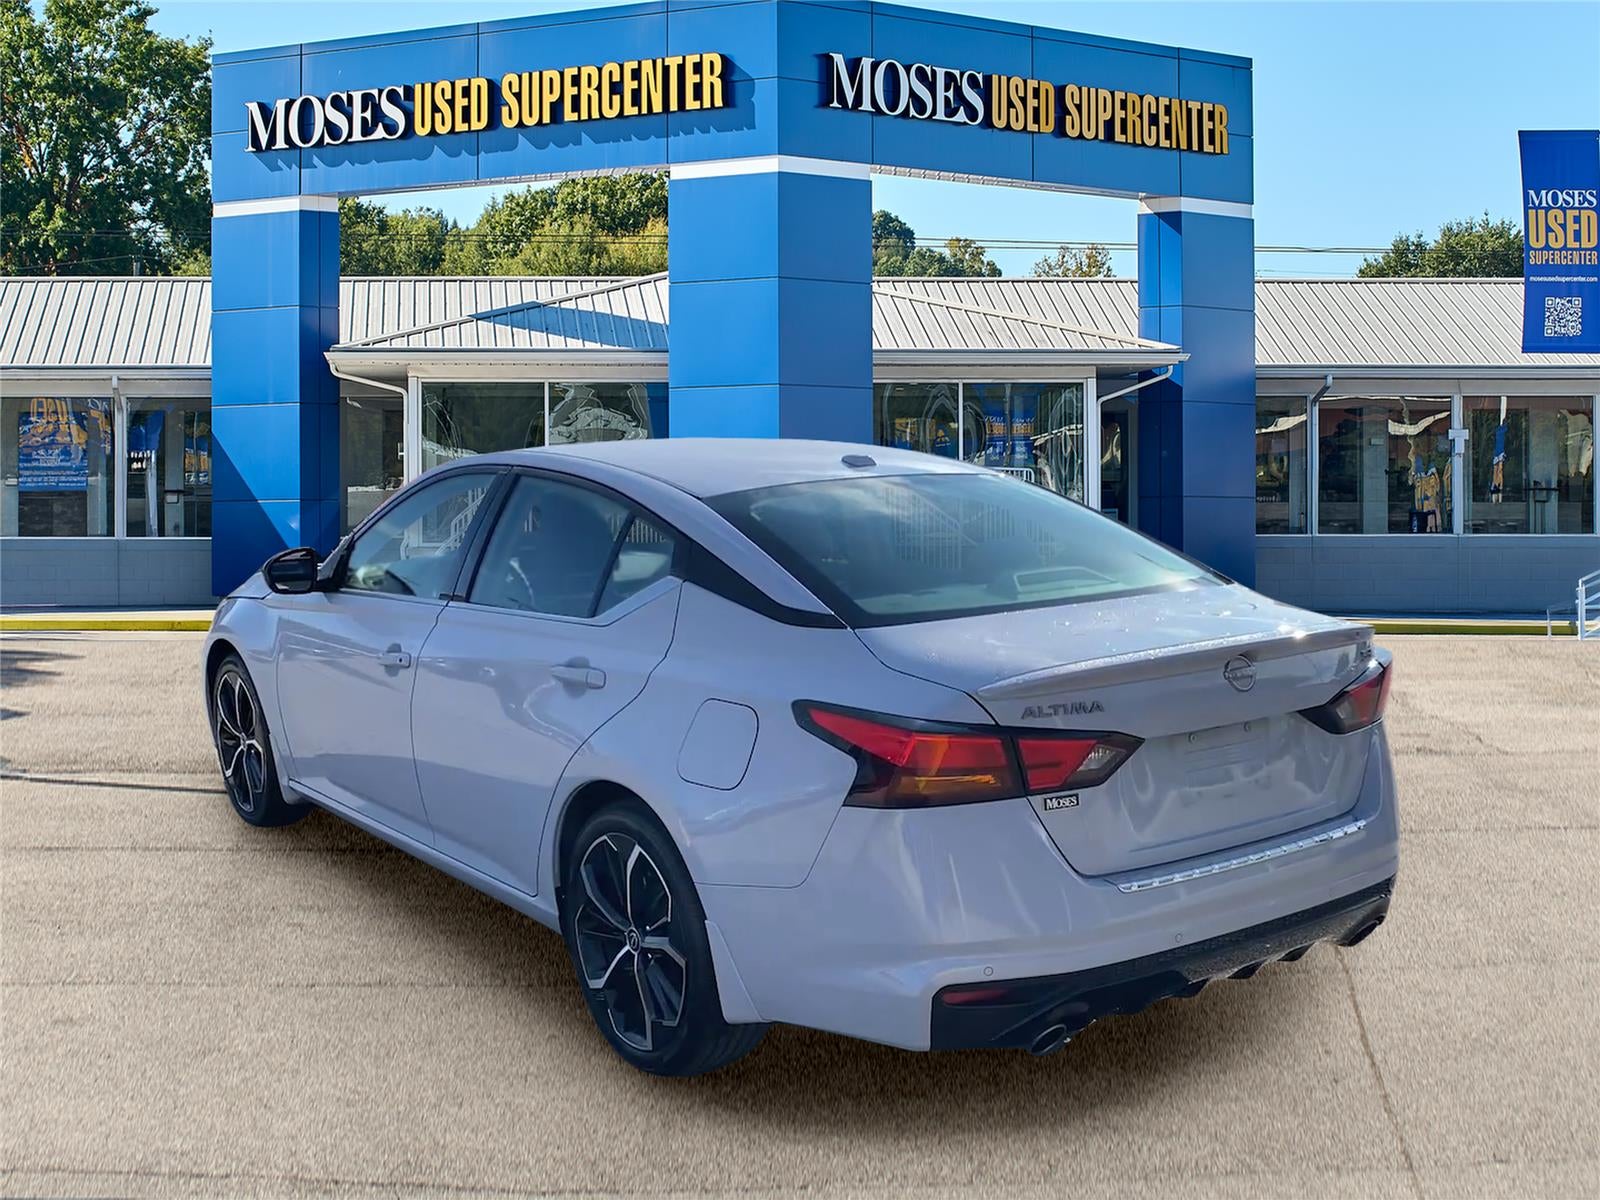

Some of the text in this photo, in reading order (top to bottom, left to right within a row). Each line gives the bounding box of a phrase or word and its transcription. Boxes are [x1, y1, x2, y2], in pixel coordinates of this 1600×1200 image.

[245, 52, 724, 153] MOSES USED SUPERCENTER
[828, 52, 1230, 155] MOSES USED SUPERCENTER
[1527, 189, 1598, 208] MOSES
[1528, 209, 1599, 249] USED
[1529, 250, 1598, 265] SUPERCENTER
[1021, 701, 1105, 720] ALTIMA
[1045, 795, 1078, 811] MOSES
